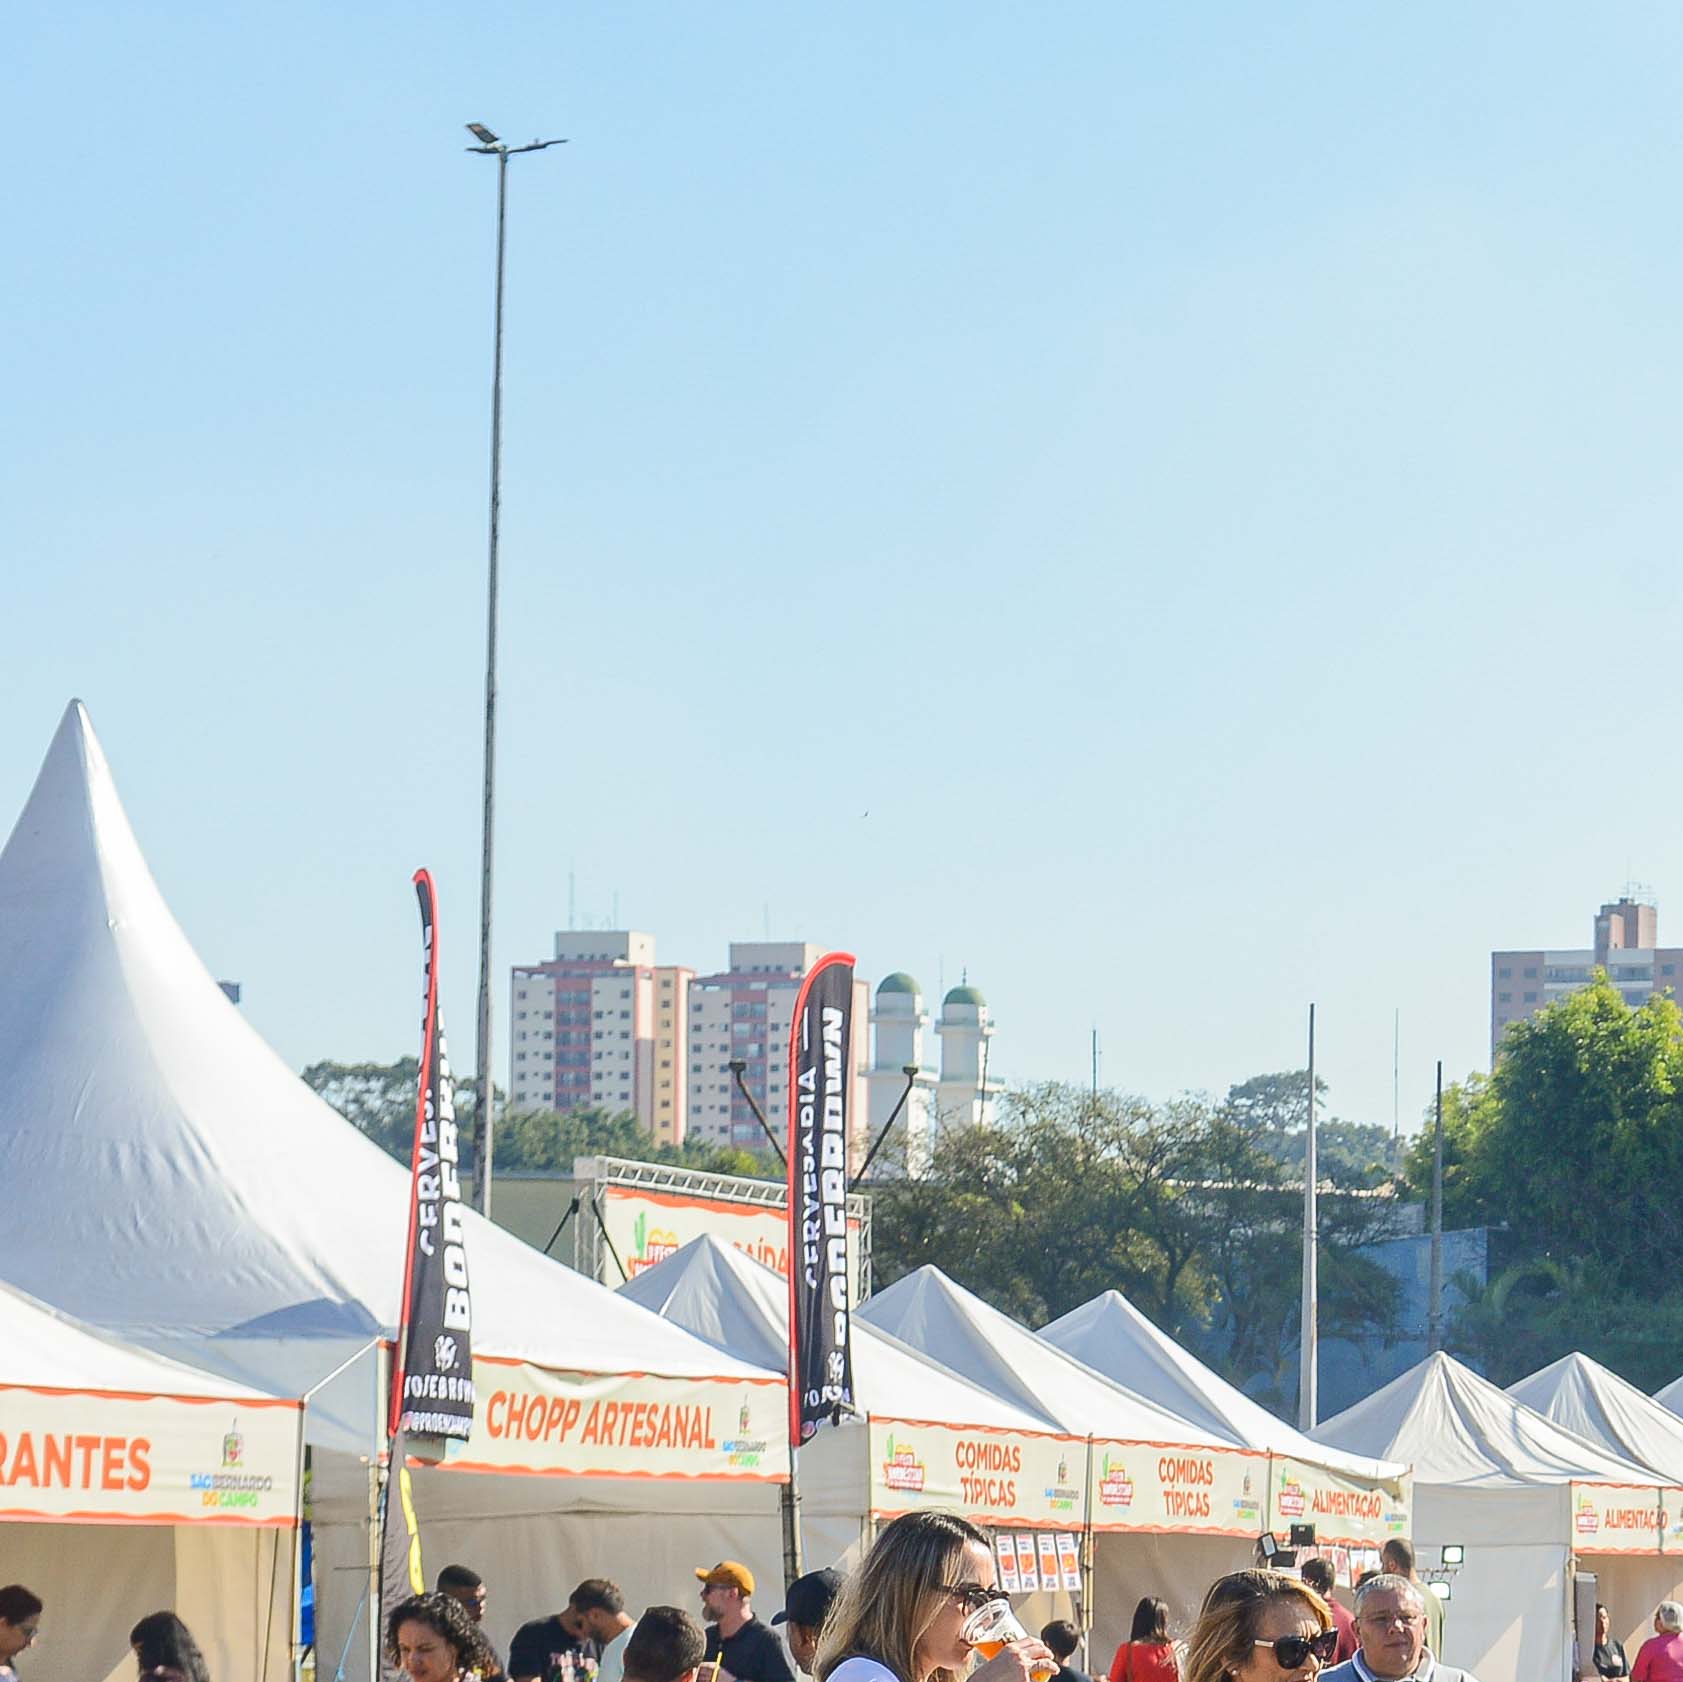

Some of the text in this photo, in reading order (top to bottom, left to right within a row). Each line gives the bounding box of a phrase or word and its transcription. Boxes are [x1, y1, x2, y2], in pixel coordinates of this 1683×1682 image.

[486, 1390, 581, 1443] CHOPP
[580, 1400, 715, 1450] ARTESANAL
[955, 1440, 1021, 1473] COMIDAS
[1158, 1457, 1214, 1486] COMIDAS
[960, 1471, 1017, 1508] TÍPICAS
[1163, 1484, 1211, 1518] TÍPICAS
[1312, 1488, 1382, 1520] ALIMENTAÇÃO
[1604, 1504, 1668, 1533] ALIMENTAÇÃO
